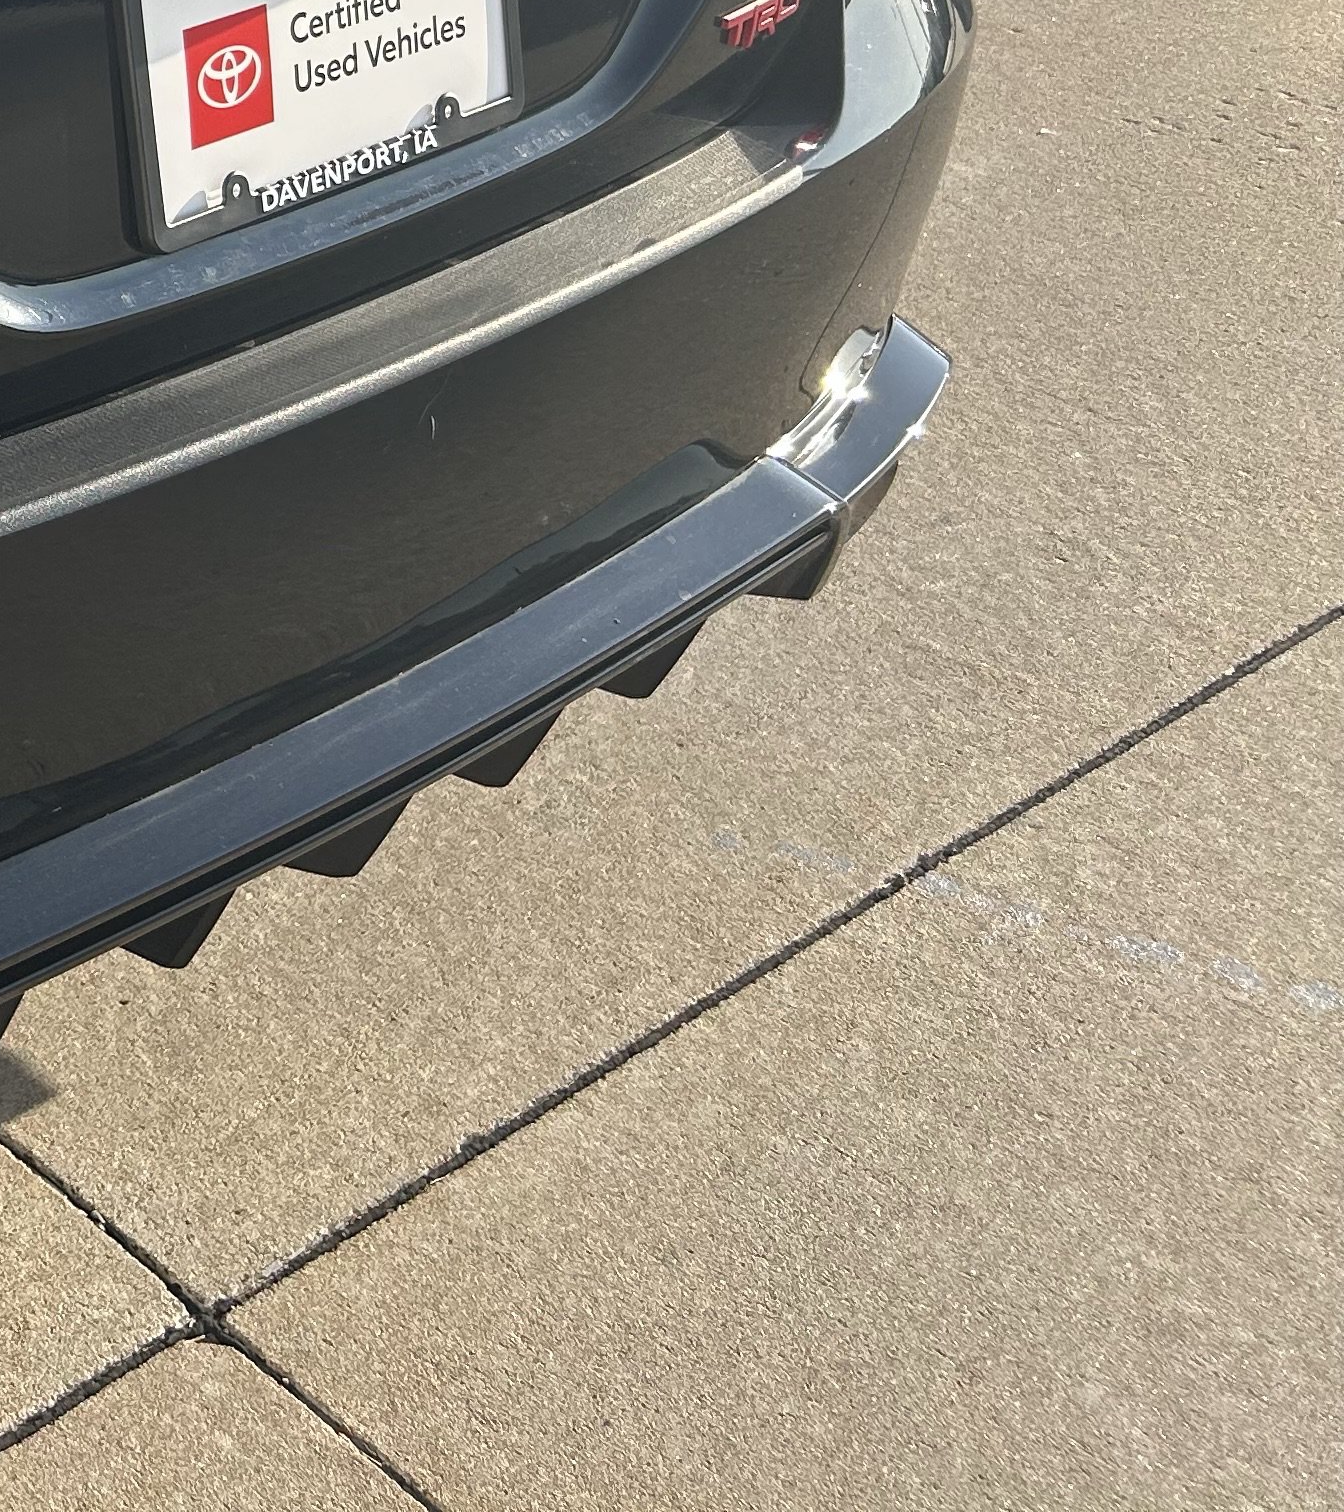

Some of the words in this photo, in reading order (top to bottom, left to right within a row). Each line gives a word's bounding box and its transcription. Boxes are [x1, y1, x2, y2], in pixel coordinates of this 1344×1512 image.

[293, 44, 359, 92] Used
[365, 14, 467, 70] Vehicles
[260, 143, 409, 213] DAVENPORT,
[412, 126, 439, 154] IA
